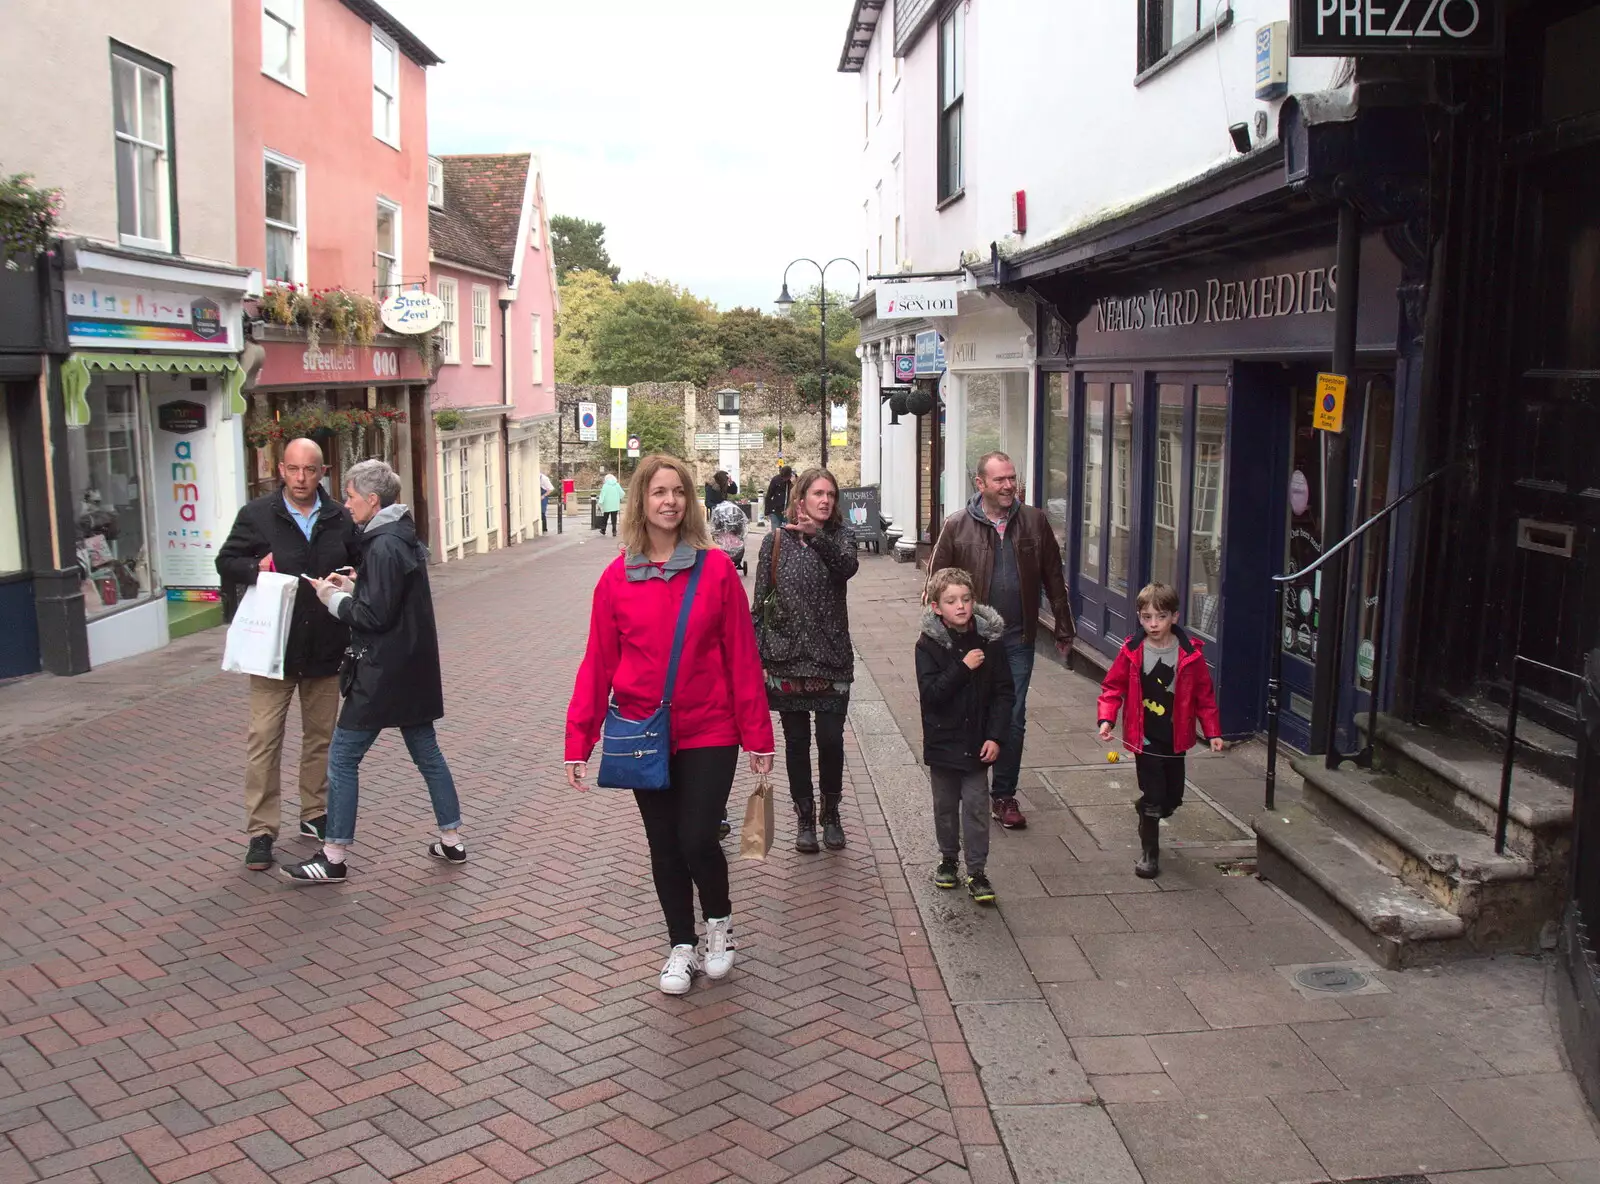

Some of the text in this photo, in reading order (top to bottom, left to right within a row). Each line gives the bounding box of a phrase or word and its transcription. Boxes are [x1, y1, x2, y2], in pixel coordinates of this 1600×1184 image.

[1317, 0, 1479, 38] PREZZO
[393, 296, 431, 310] Street
[1149, 287, 1199, 328] YARD
[1203, 264, 1338, 323] REMEDIES
[397, 309, 428, 322] Level
